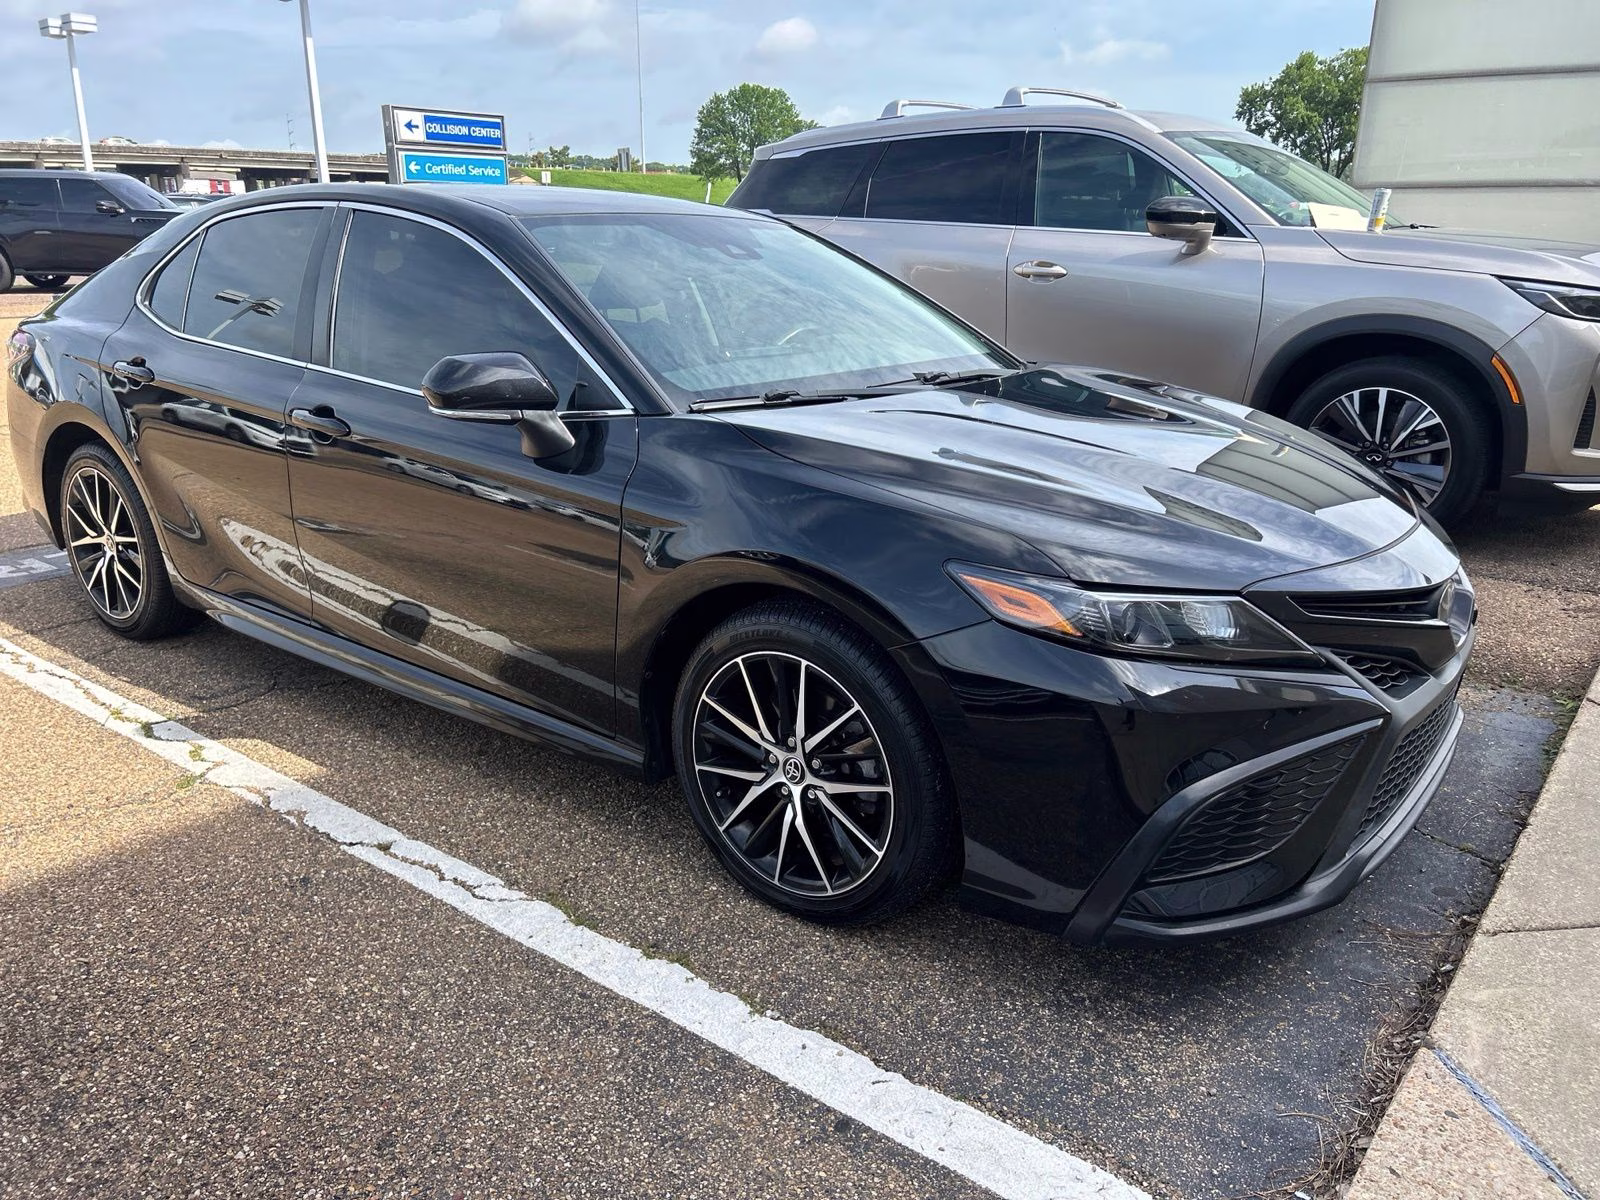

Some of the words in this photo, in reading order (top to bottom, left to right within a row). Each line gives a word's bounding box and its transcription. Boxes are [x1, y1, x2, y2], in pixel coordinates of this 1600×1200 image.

[426, 122, 469, 136] COLLISION
[470, 126, 501, 138] CENTER
[425, 162, 466, 175] Certified
[467, 165, 501, 177] Service
